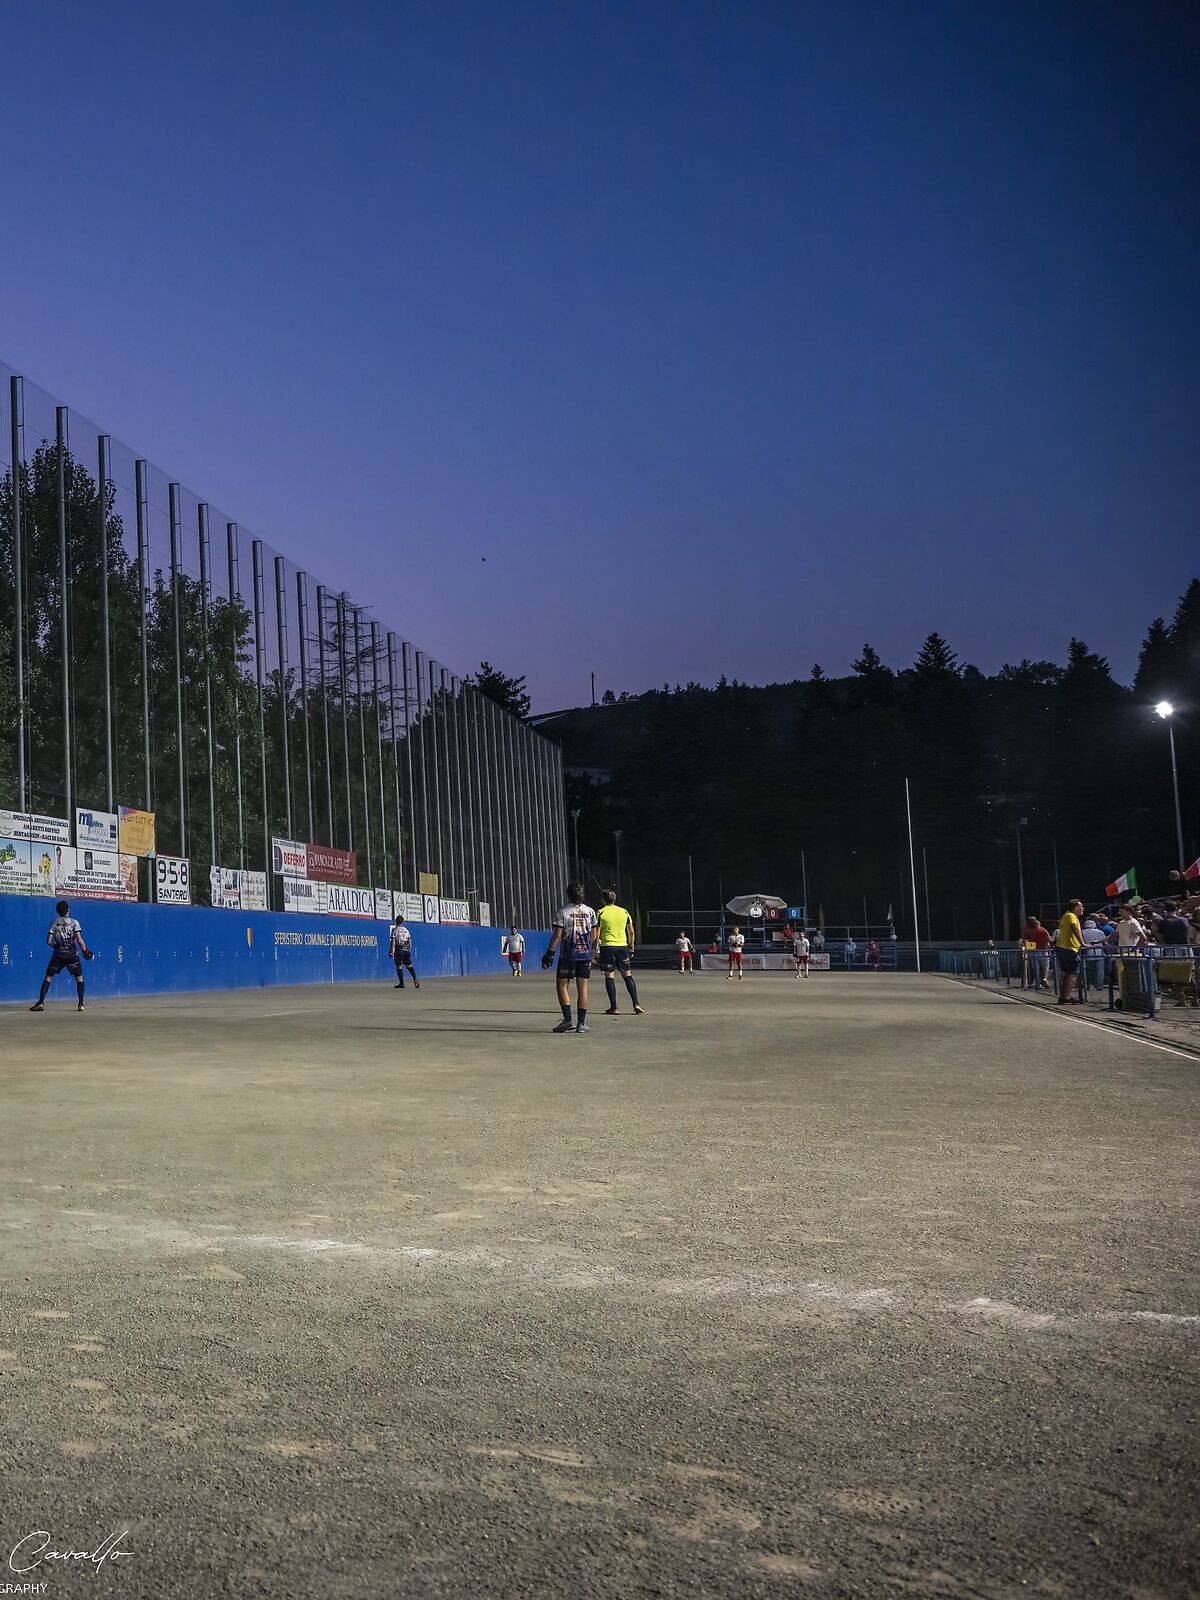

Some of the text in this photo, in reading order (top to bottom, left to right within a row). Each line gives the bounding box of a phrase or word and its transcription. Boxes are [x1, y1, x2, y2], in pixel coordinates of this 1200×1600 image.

[158, 888, 187, 900] SANTERO
[328, 888, 374, 914] ARALDICA
[440, 900, 469, 921] ARALDICA
[274, 932, 303, 945] SFERISTERIO
[334, 935, 361, 947] MONASTERO
